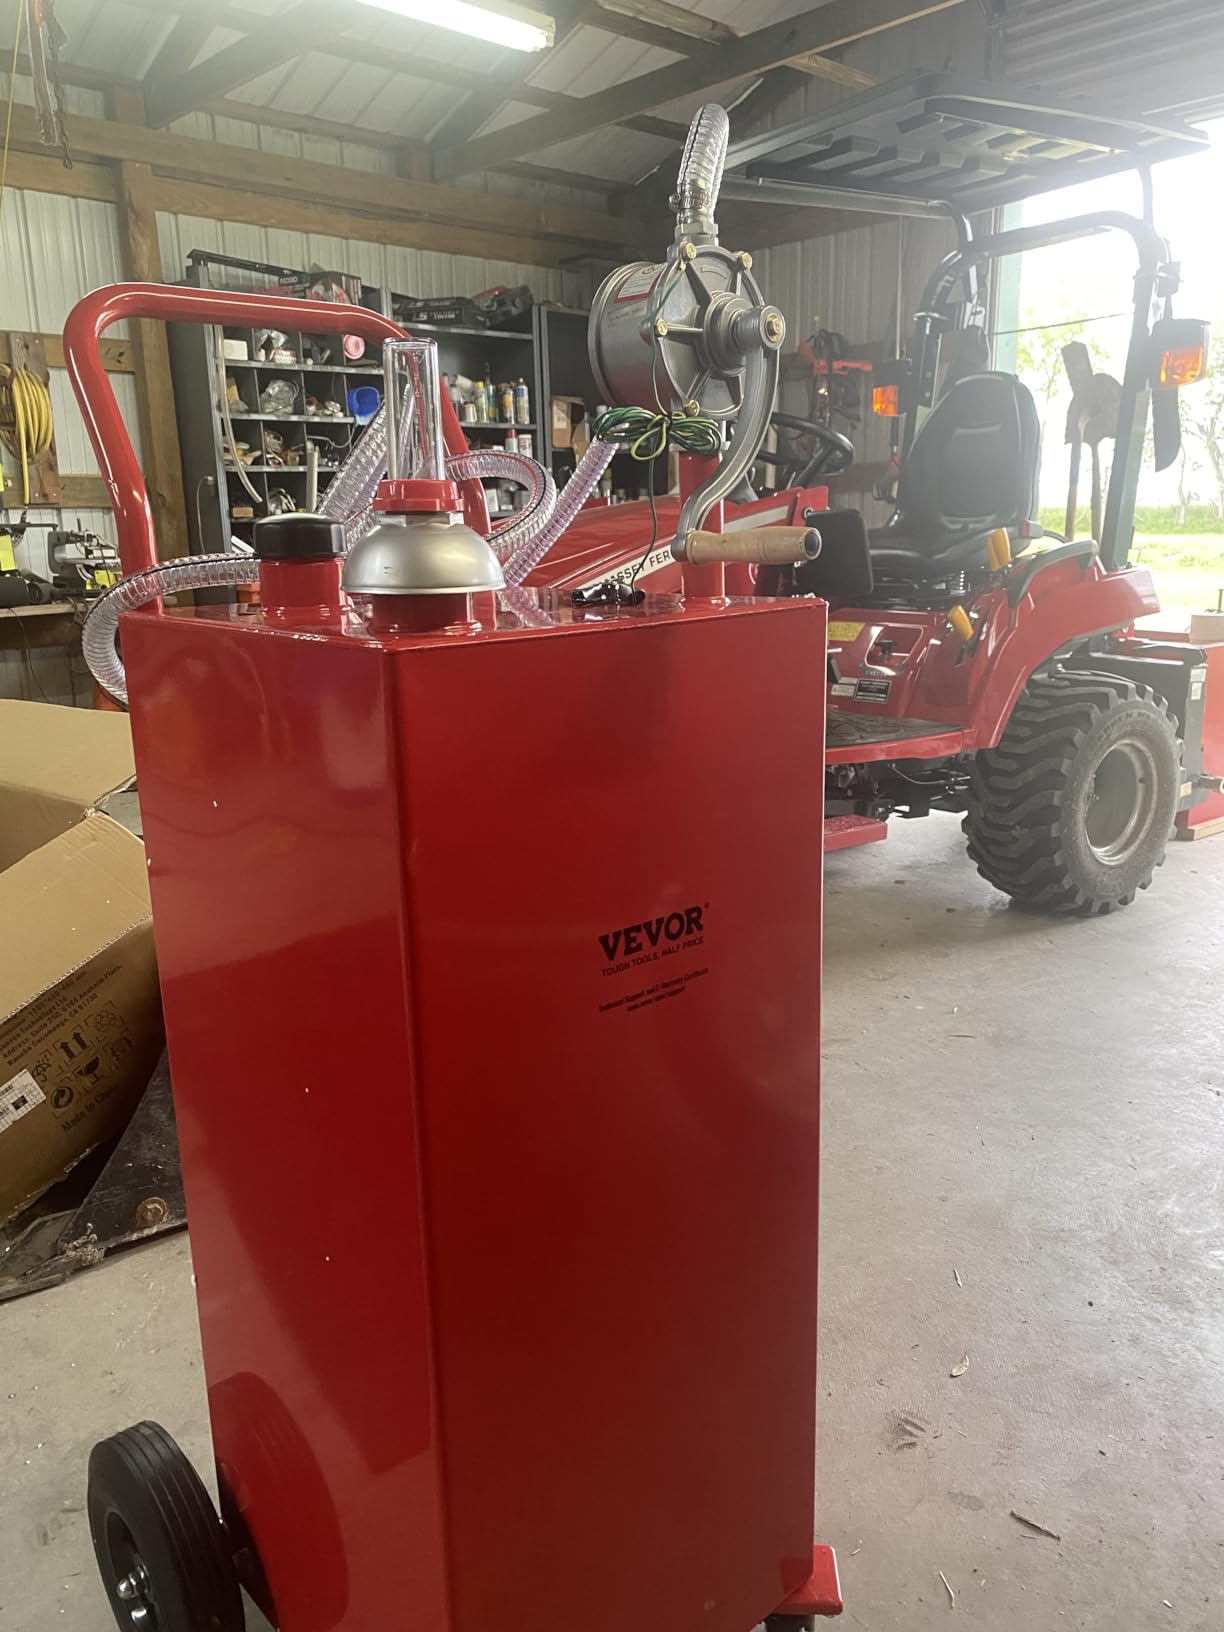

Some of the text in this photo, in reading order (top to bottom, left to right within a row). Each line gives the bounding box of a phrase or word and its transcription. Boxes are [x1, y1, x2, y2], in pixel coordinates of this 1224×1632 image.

[599, 905, 703, 962] VEVOR
[601, 963, 631, 977] TOUGH
[661, 943, 682, 957] HALF
[682, 935, 704, 950] PRICE
